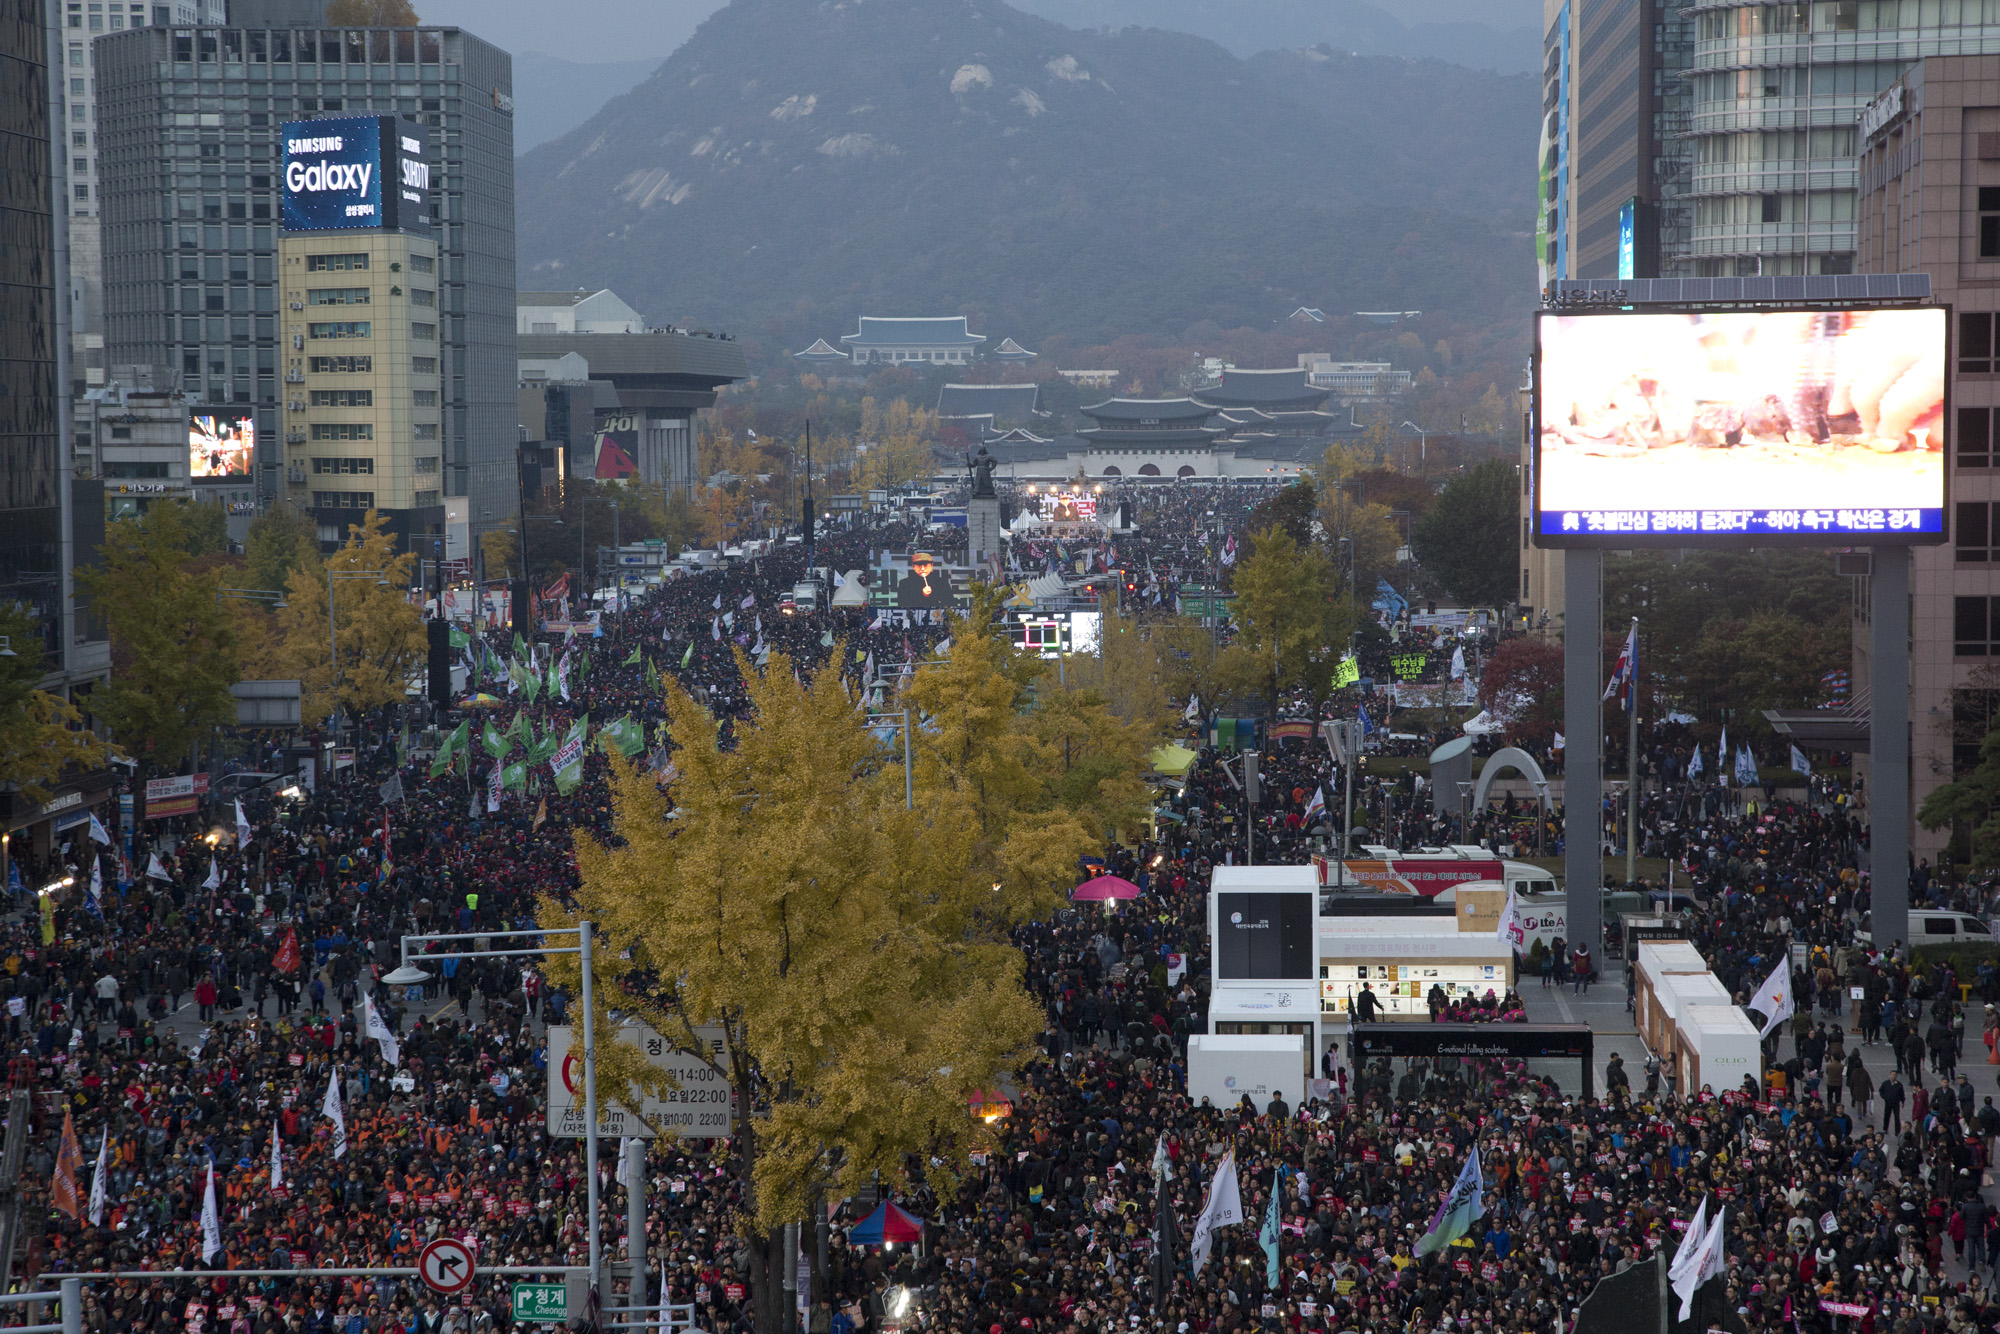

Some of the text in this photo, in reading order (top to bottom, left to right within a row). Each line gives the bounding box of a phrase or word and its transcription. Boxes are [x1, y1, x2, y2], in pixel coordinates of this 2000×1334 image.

[288, 136, 343, 154] SAMSUNG
[286, 160, 372, 198] Galaxy
[1391, 657, 1426, 667] 예수님을
[1438, 872, 1457, 880] 데이터
[1484, 1044, 1509, 1054] sculpture
